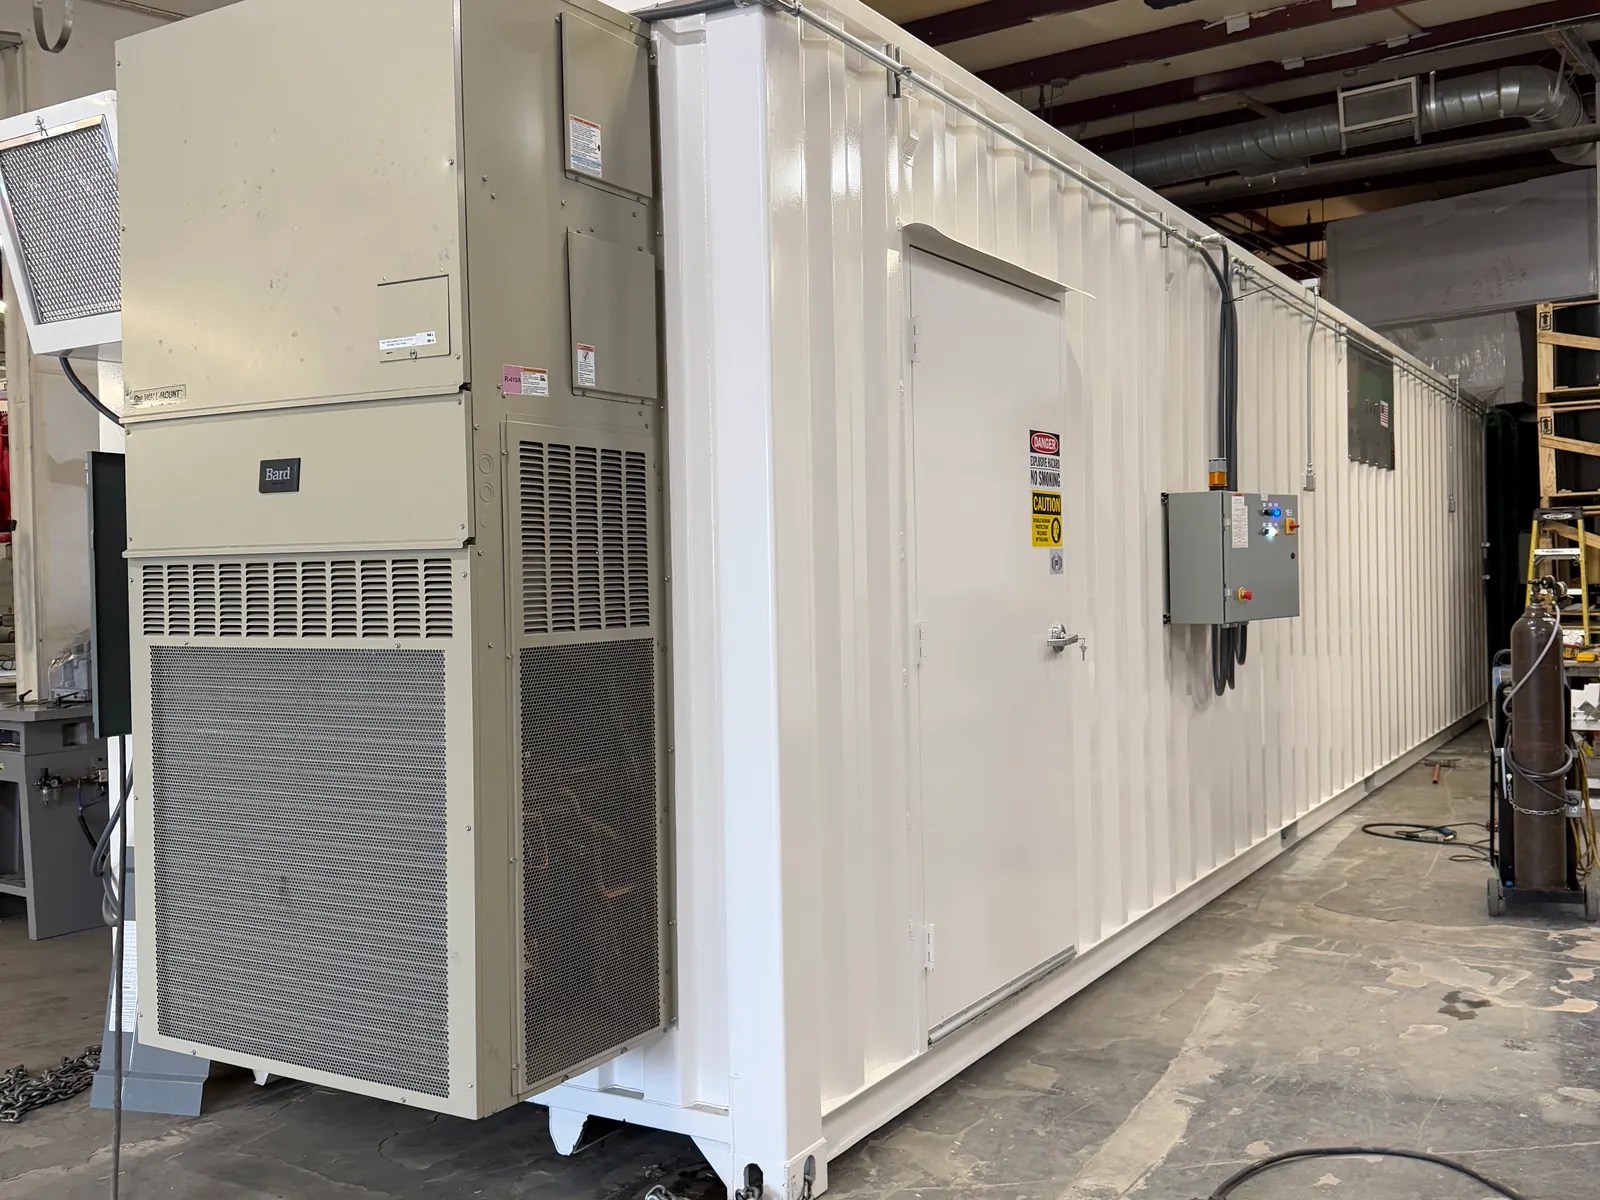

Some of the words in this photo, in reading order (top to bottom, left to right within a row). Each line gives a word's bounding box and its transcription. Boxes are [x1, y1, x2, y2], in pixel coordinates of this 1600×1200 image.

[1034, 436, 1056, 450] DANGER
[1031, 456, 1048, 467] EXPLOSIVE
[1048, 458, 1060, 469] HAZARD
[265, 466, 291, 481] Bard
[1031, 470, 1038, 486] NO
[1039, 471, 1060, 487] SMOKING
[1034, 496, 1061, 512] CAUTION
